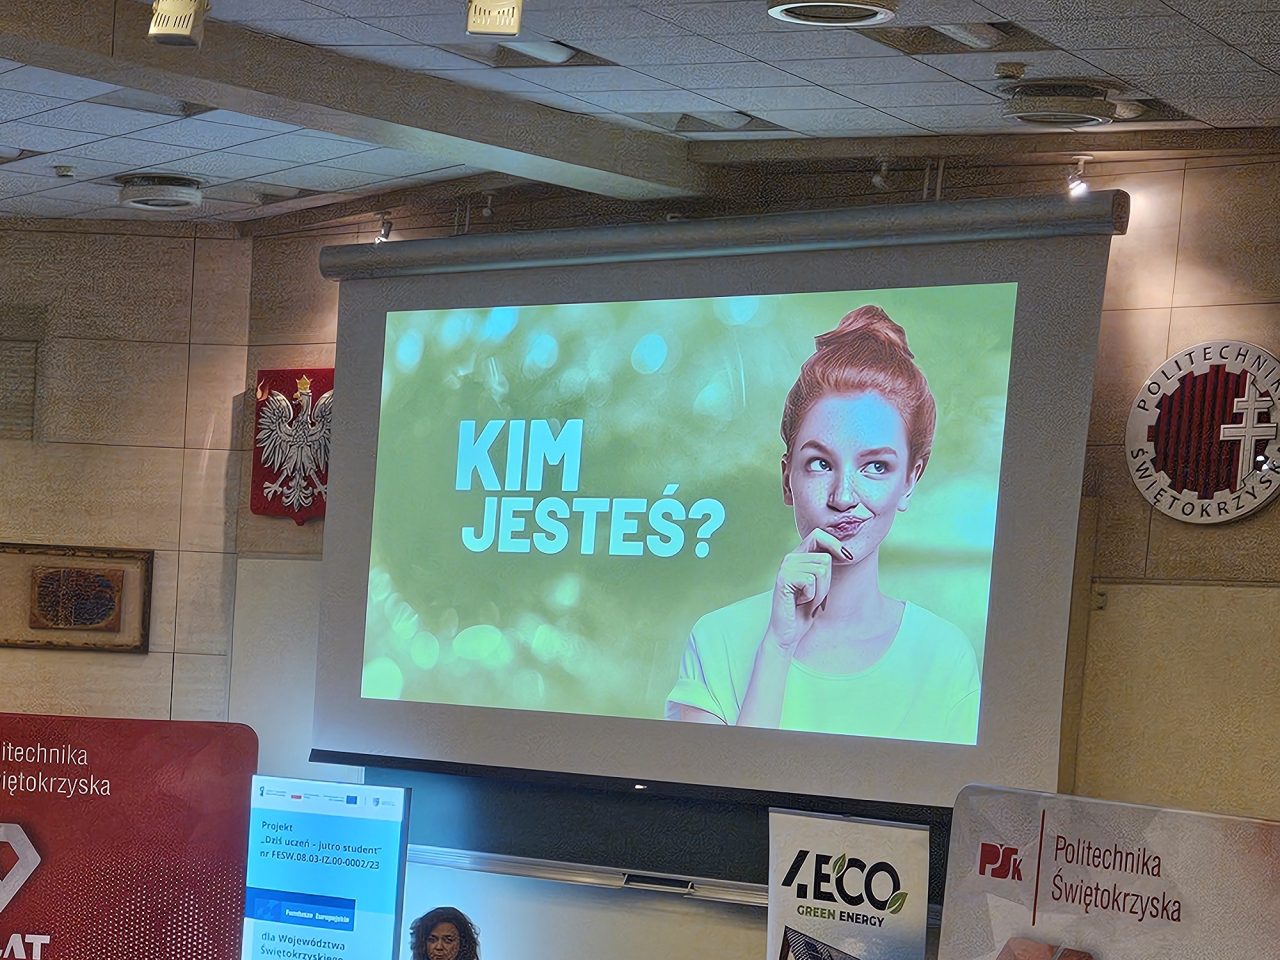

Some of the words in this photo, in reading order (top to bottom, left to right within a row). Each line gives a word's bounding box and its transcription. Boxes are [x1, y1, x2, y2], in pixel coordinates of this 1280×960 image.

[455, 419, 584, 492] KIM
[461, 484, 726, 559] JESTEŚ?
[261, 820, 293, 833] Projekt
[284, 838, 310, 848] uczeń
[317, 840, 341, 852] jutro
[1054, 835, 1162, 878] Politechnika
[1051, 869, 1182, 923] Świętokrzyska
[797, 904, 836, 921] GREEN
[839, 910, 885, 928] ENERGY
[261, 931, 276, 942] dla
[278, 934, 345, 951] Województwa
